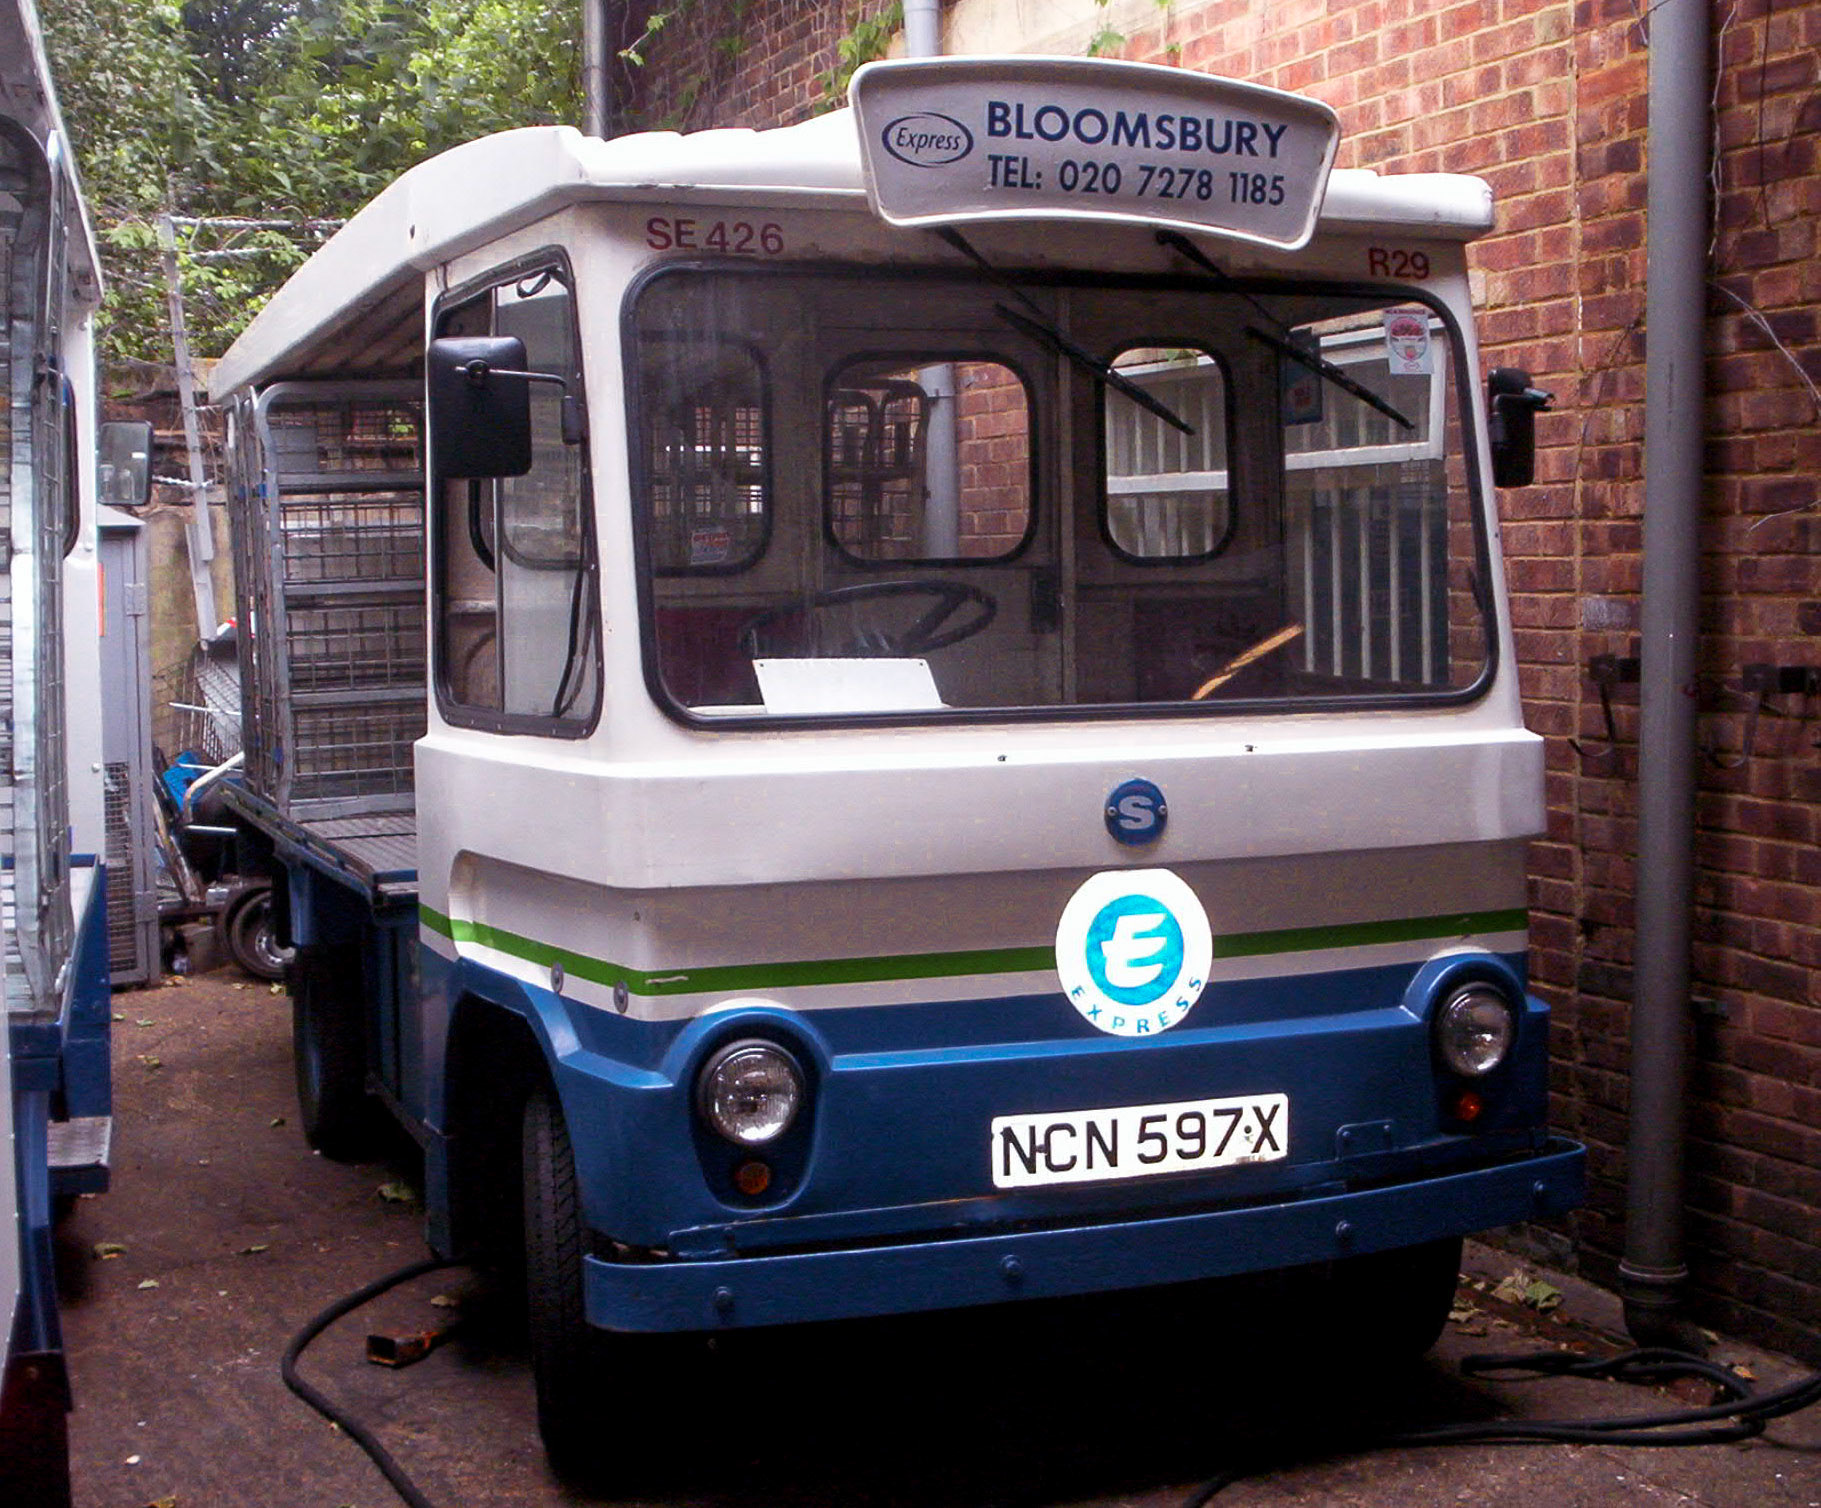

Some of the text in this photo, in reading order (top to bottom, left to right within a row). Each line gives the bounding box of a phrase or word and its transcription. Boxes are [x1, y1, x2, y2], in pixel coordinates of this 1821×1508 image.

[896, 127, 961, 154] Express
[987, 101, 1288, 158] BLOOMSBURY
[988, 154, 1285, 206] TEL: 020 7278 1185
[646, 217, 784, 255] SE 426
[1368, 247, 1430, 280] R29
[1117, 795, 1156, 830] S
[1071, 976, 1203, 1034] EXPRESS
[1001, 1103, 1281, 1176] NCN 597X
